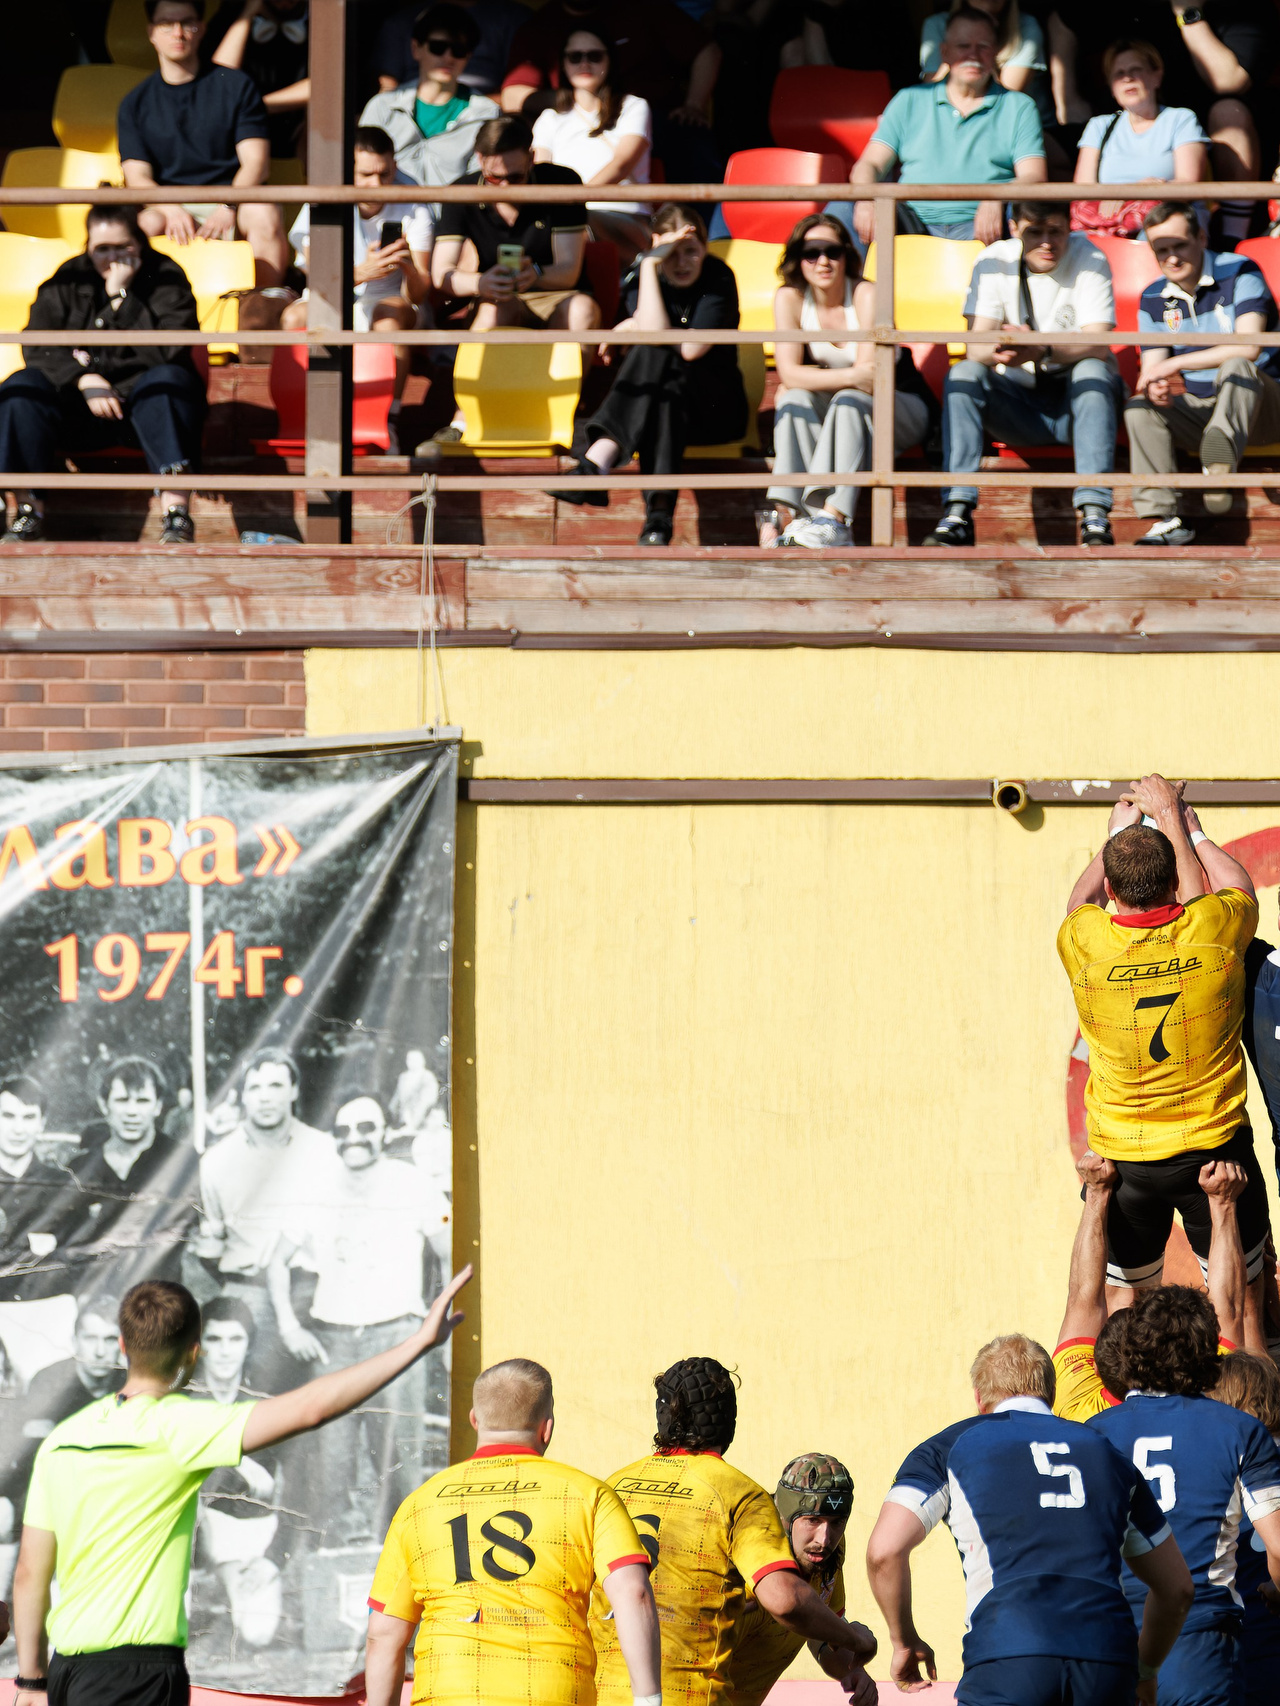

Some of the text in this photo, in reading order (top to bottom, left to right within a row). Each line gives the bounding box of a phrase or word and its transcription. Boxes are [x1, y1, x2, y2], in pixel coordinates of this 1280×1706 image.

[44, 931, 304, 1002] 1974г.
[1133, 991, 1183, 1063] 7
[1029, 1441, 1086, 1509] 5
[1133, 1436, 1177, 1513] 5
[444, 1510, 536, 1585] 18
